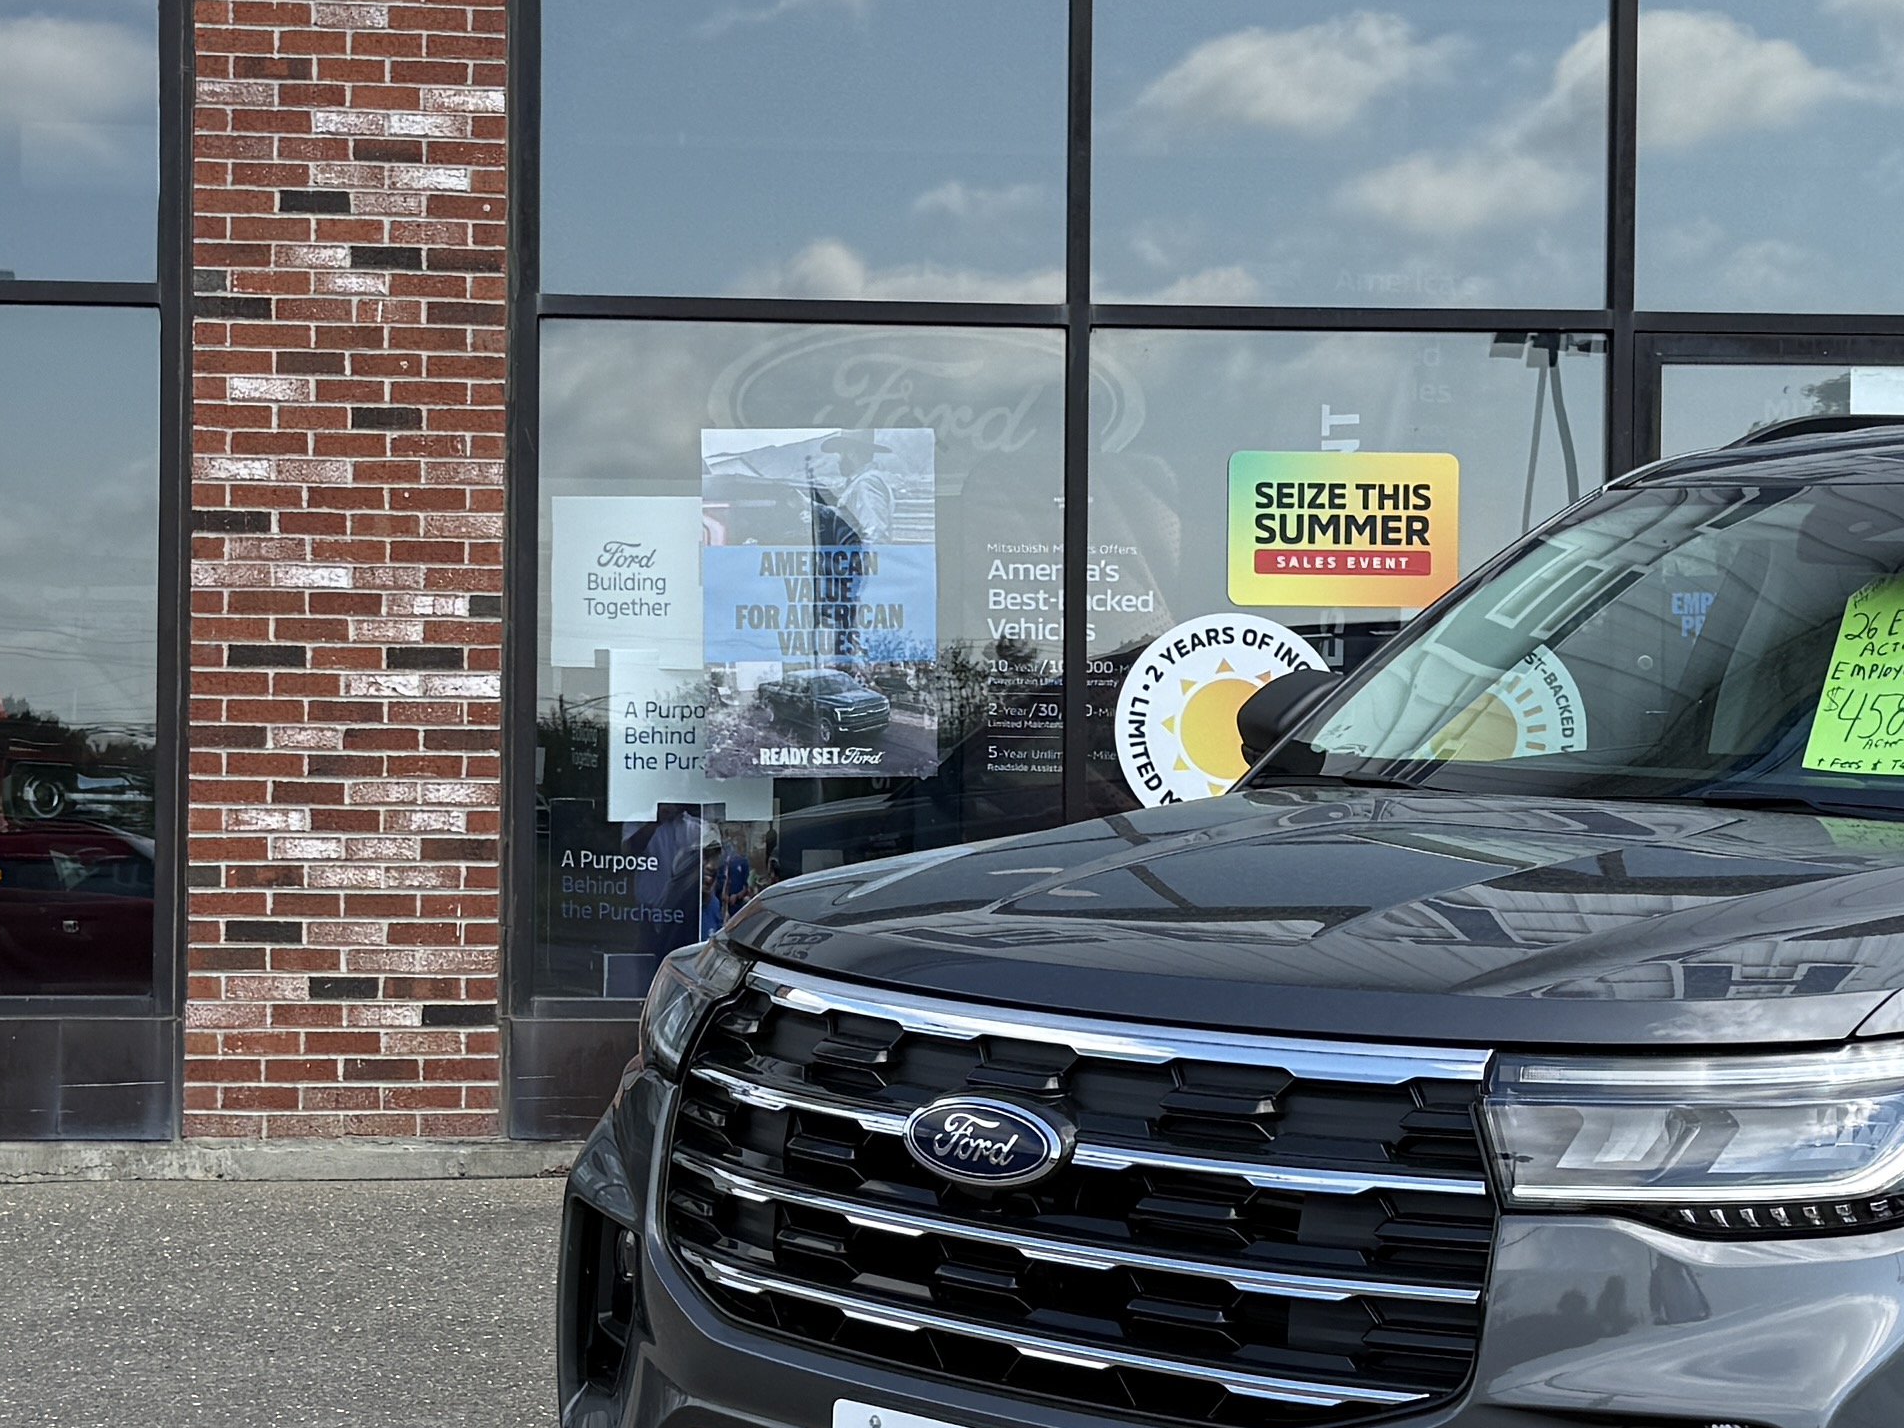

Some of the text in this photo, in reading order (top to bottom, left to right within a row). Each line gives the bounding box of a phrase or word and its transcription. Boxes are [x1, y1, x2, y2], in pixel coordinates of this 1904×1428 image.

[1254, 481, 1432, 512] SEIZE THIS
[1254, 513, 1431, 546] SUMMER
[597, 541, 656, 568] Ford
[987, 543, 1049, 554] Mitsubishi
[1099, 544, 1138, 555] Offers
[759, 551, 879, 576] AMERICAN
[988, 559, 1119, 582] Amera's
[1276, 555, 1409, 570] SALES EVENT
[587, 573, 666, 595] Building
[784, 578, 860, 603] VALUE.
[584, 598, 671, 619] Together
[735, 605, 904, 630] FOR AMERICAN
[1844, 612, 1881, 641] 26
[777, 631, 869, 656] VALUES.
[1145, 664, 1165, 684] 2
[1158, 626, 1235, 667] YEARS
[1241, 628, 1275, 651] OF
[624, 701, 705, 721] A Purpo
[624, 727, 696, 745] Behind
[1127, 696, 1164, 792] LIMITED
[624, 753, 658, 770] the
[759, 748, 883, 766] READY SET Ford
[561, 850, 658, 872] A Purpose
[562, 876, 627, 895] Behind
[561, 902, 685, 923] the Purchase
[933, 1112, 1018, 1167] Ford
